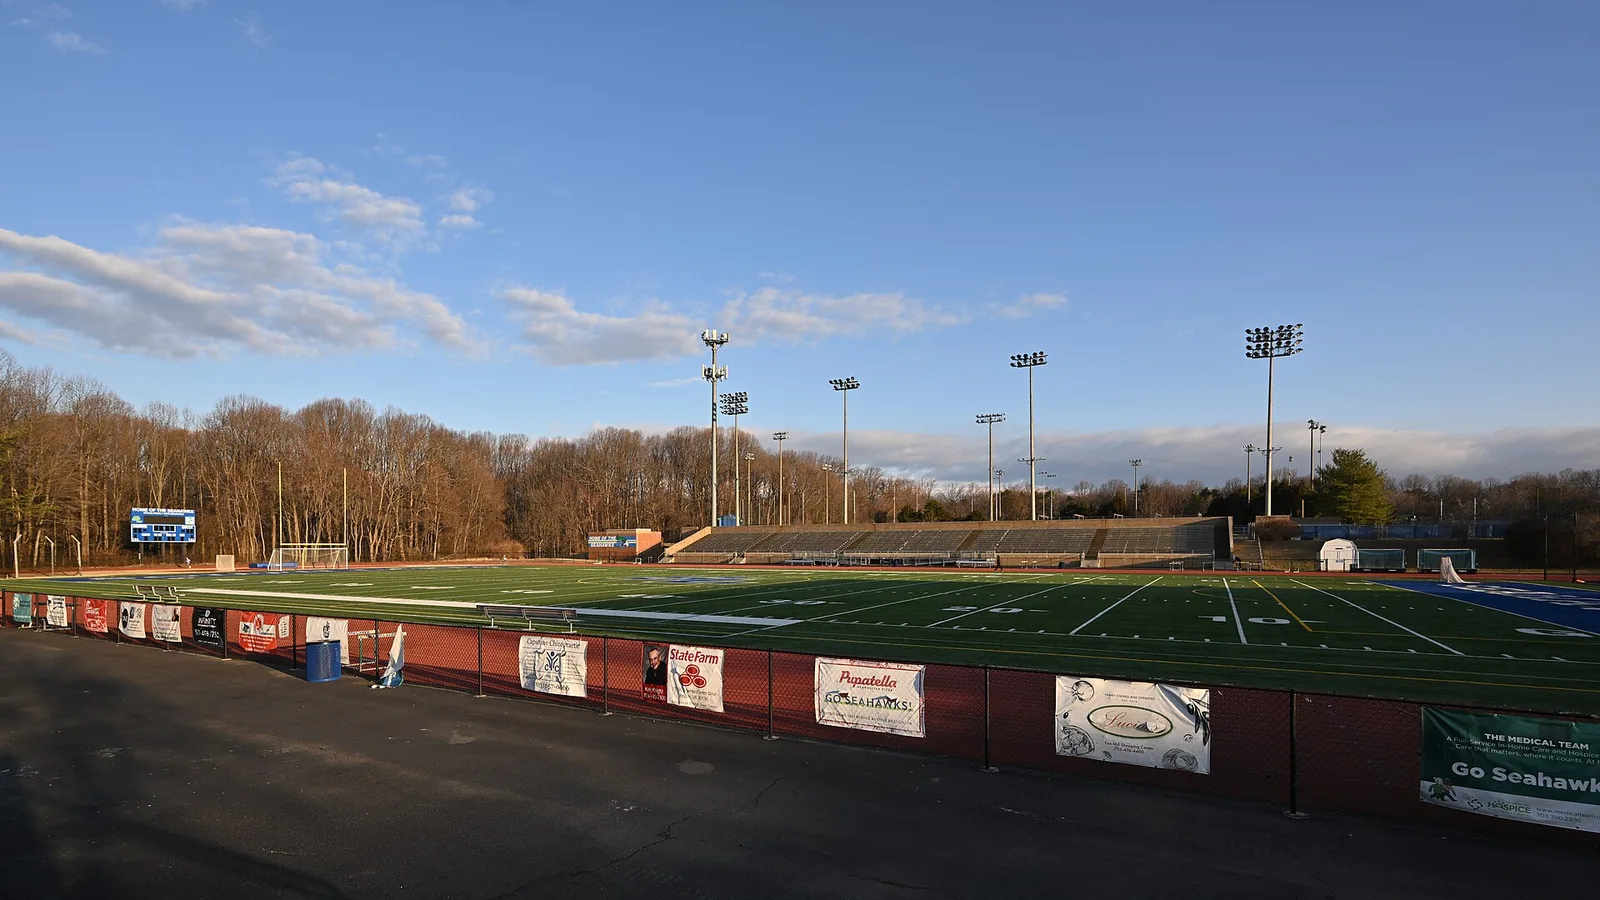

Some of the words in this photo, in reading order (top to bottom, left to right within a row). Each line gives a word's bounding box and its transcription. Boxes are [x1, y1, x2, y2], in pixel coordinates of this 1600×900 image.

[839, 670, 898, 688] Pupatella
[826, 693, 841, 703] GO
[845, 695, 912, 711] SEAHAWKS!
[1454, 736, 1496, 748] Full-Service
[1498, 742, 1530, 751] In-Home
[1568, 750, 1600, 759] Hospice
[1484, 733, 1506, 742] THE
[1508, 736, 1556, 747] MEDICAL
[1558, 741, 1589, 750] TEAM
[1474, 745, 1489, 753] that
[1490, 748, 1522, 758] matters,
[1555, 755, 1584, 764] counts.
[1452, 762, 1485, 778] Go
[1492, 766, 1600, 793] Seahawk
[1488, 800, 1531, 814] HOSPICE
